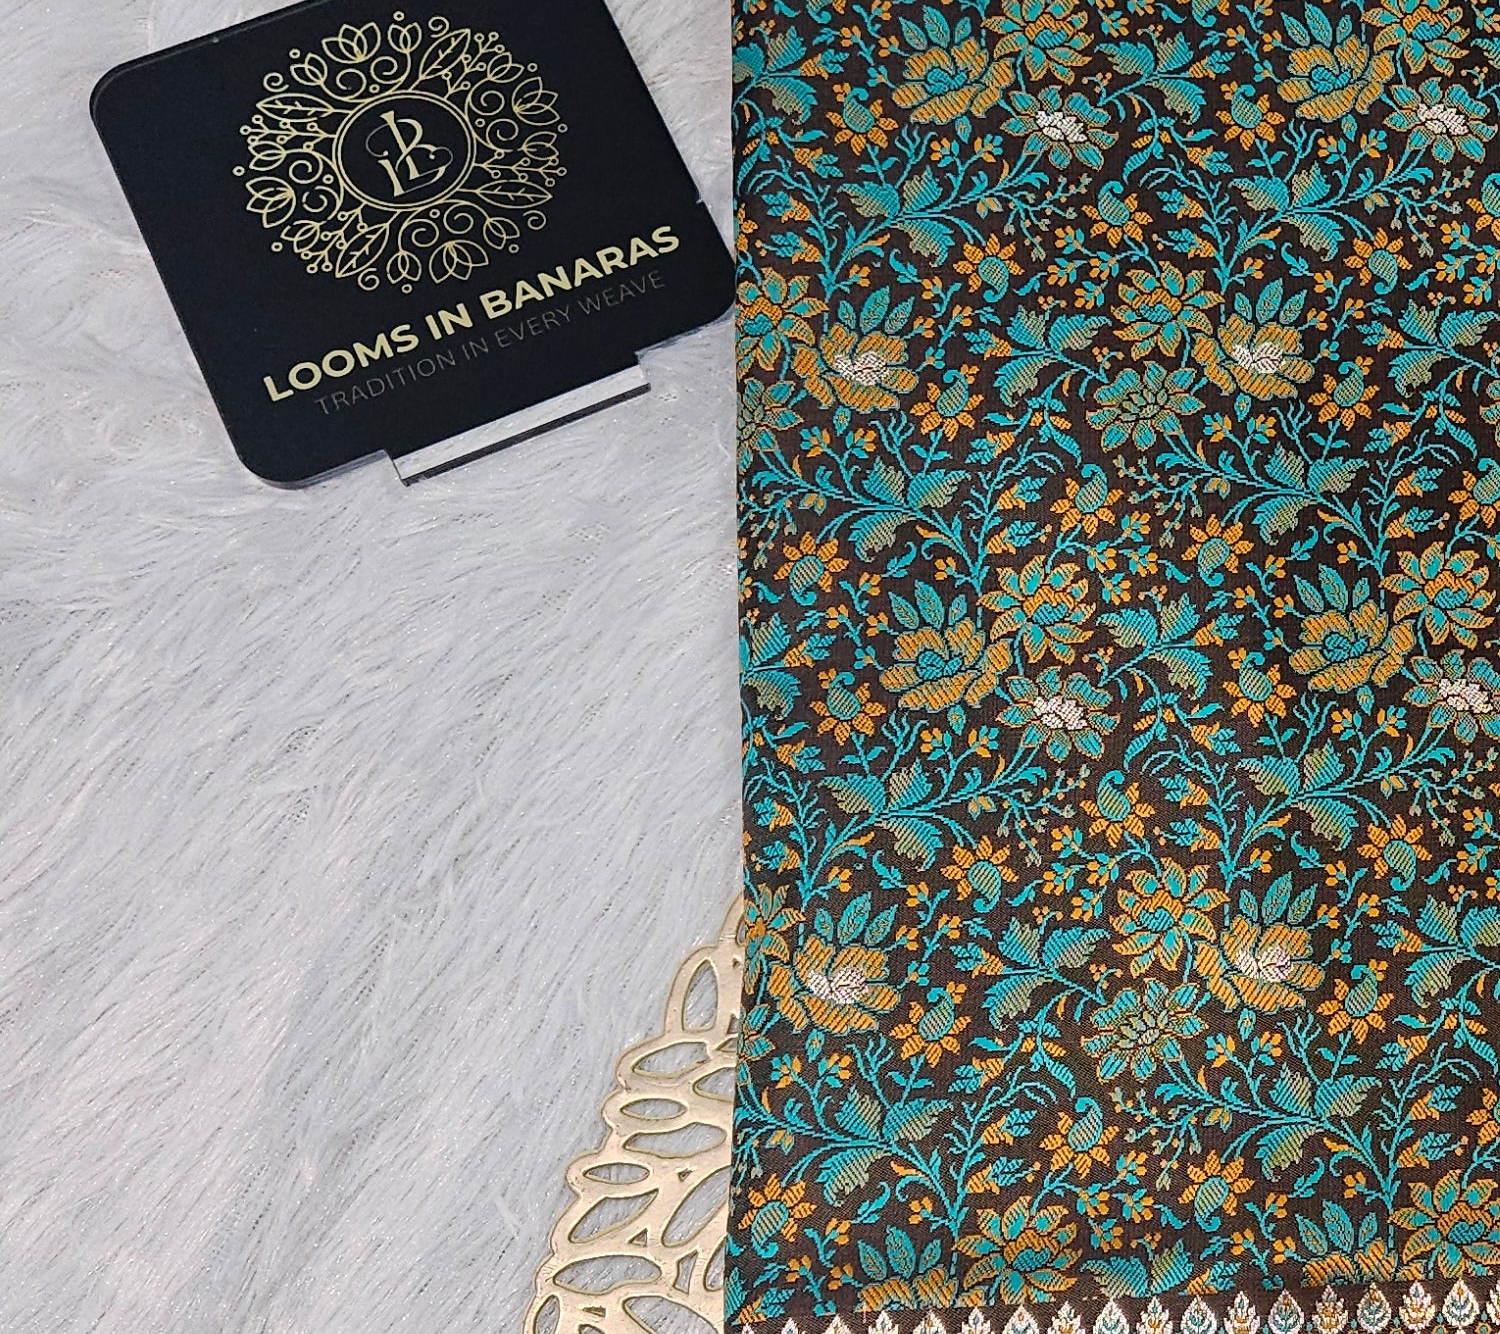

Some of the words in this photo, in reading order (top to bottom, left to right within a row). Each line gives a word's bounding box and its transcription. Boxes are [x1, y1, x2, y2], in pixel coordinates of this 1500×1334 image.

[263, 324, 420, 402] LOOMS
[425, 302, 474, 341] IN
[479, 225, 680, 319] BANARAS
[314, 350, 456, 415] TRADITION
[461, 337, 489, 361] IN
[494, 304, 571, 348] EVERY
[577, 269, 665, 315] WEAVE
